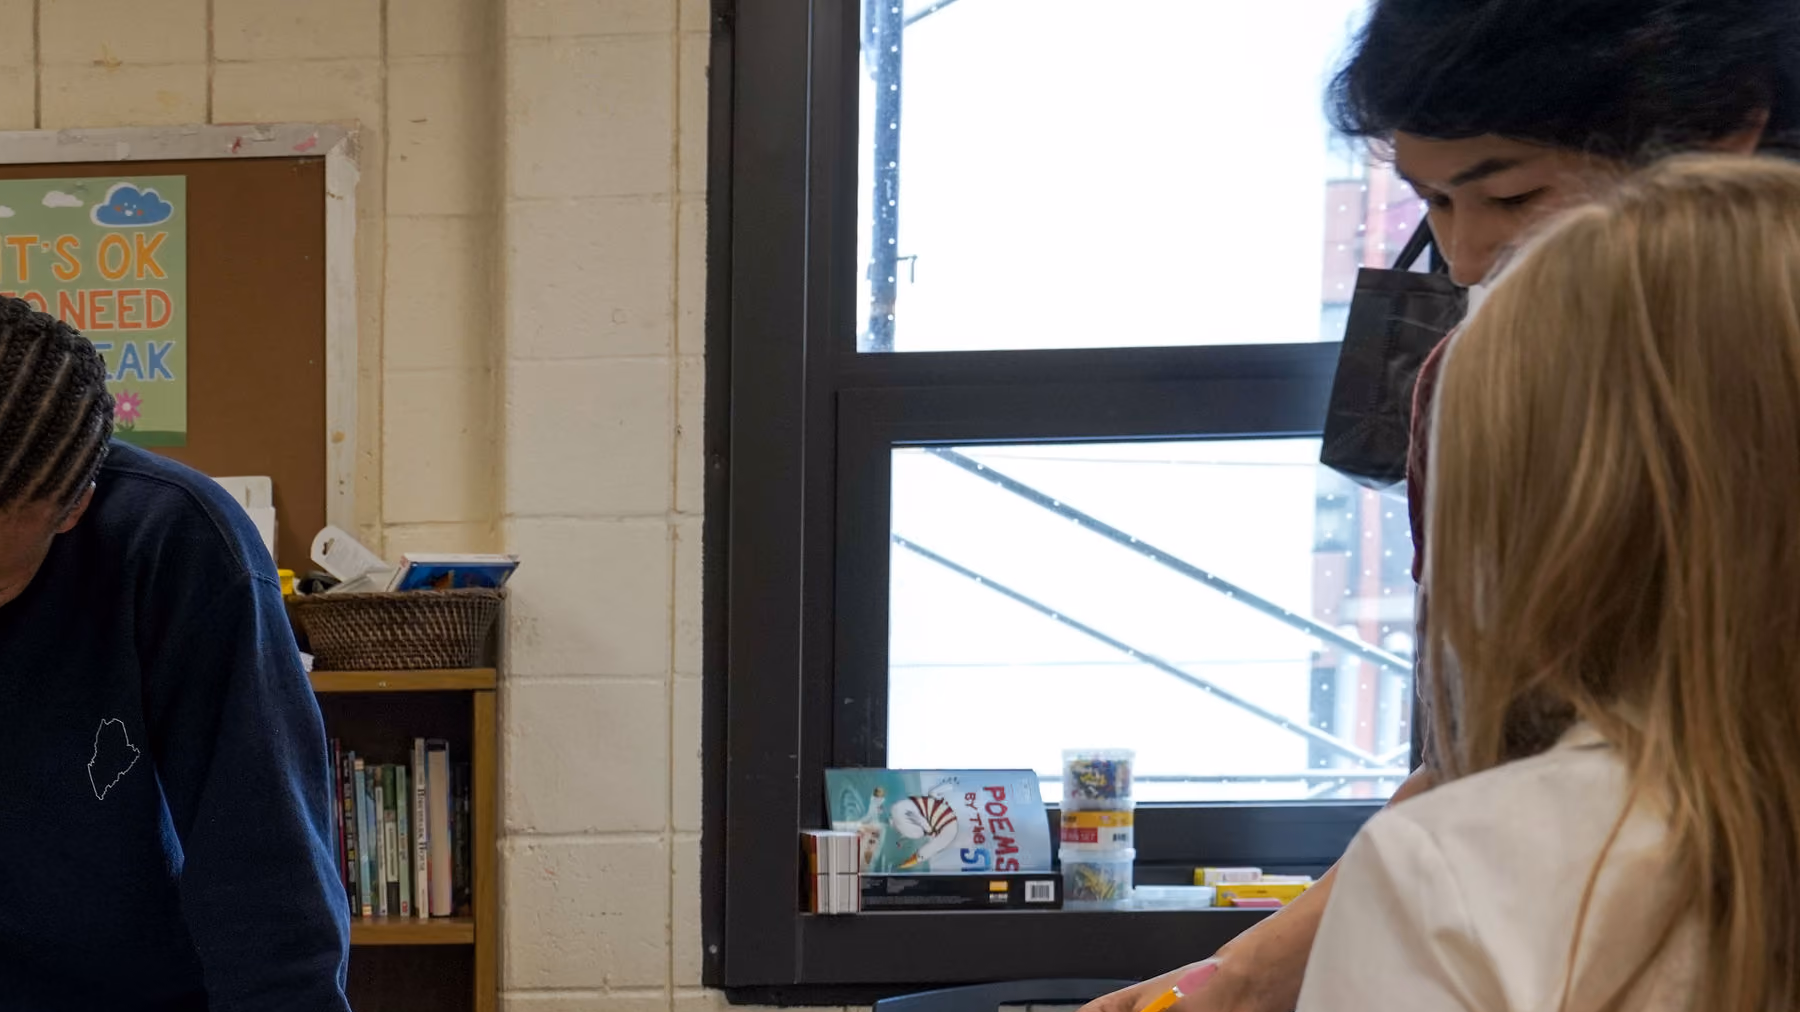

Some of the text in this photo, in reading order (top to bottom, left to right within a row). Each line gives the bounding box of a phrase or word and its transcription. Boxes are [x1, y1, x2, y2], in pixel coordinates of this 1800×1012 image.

[97, 231, 168, 280] OK
[57, 288, 172, 331] NEED
[965, 792, 978, 811] BY
[983, 786, 1020, 872] POEMS
